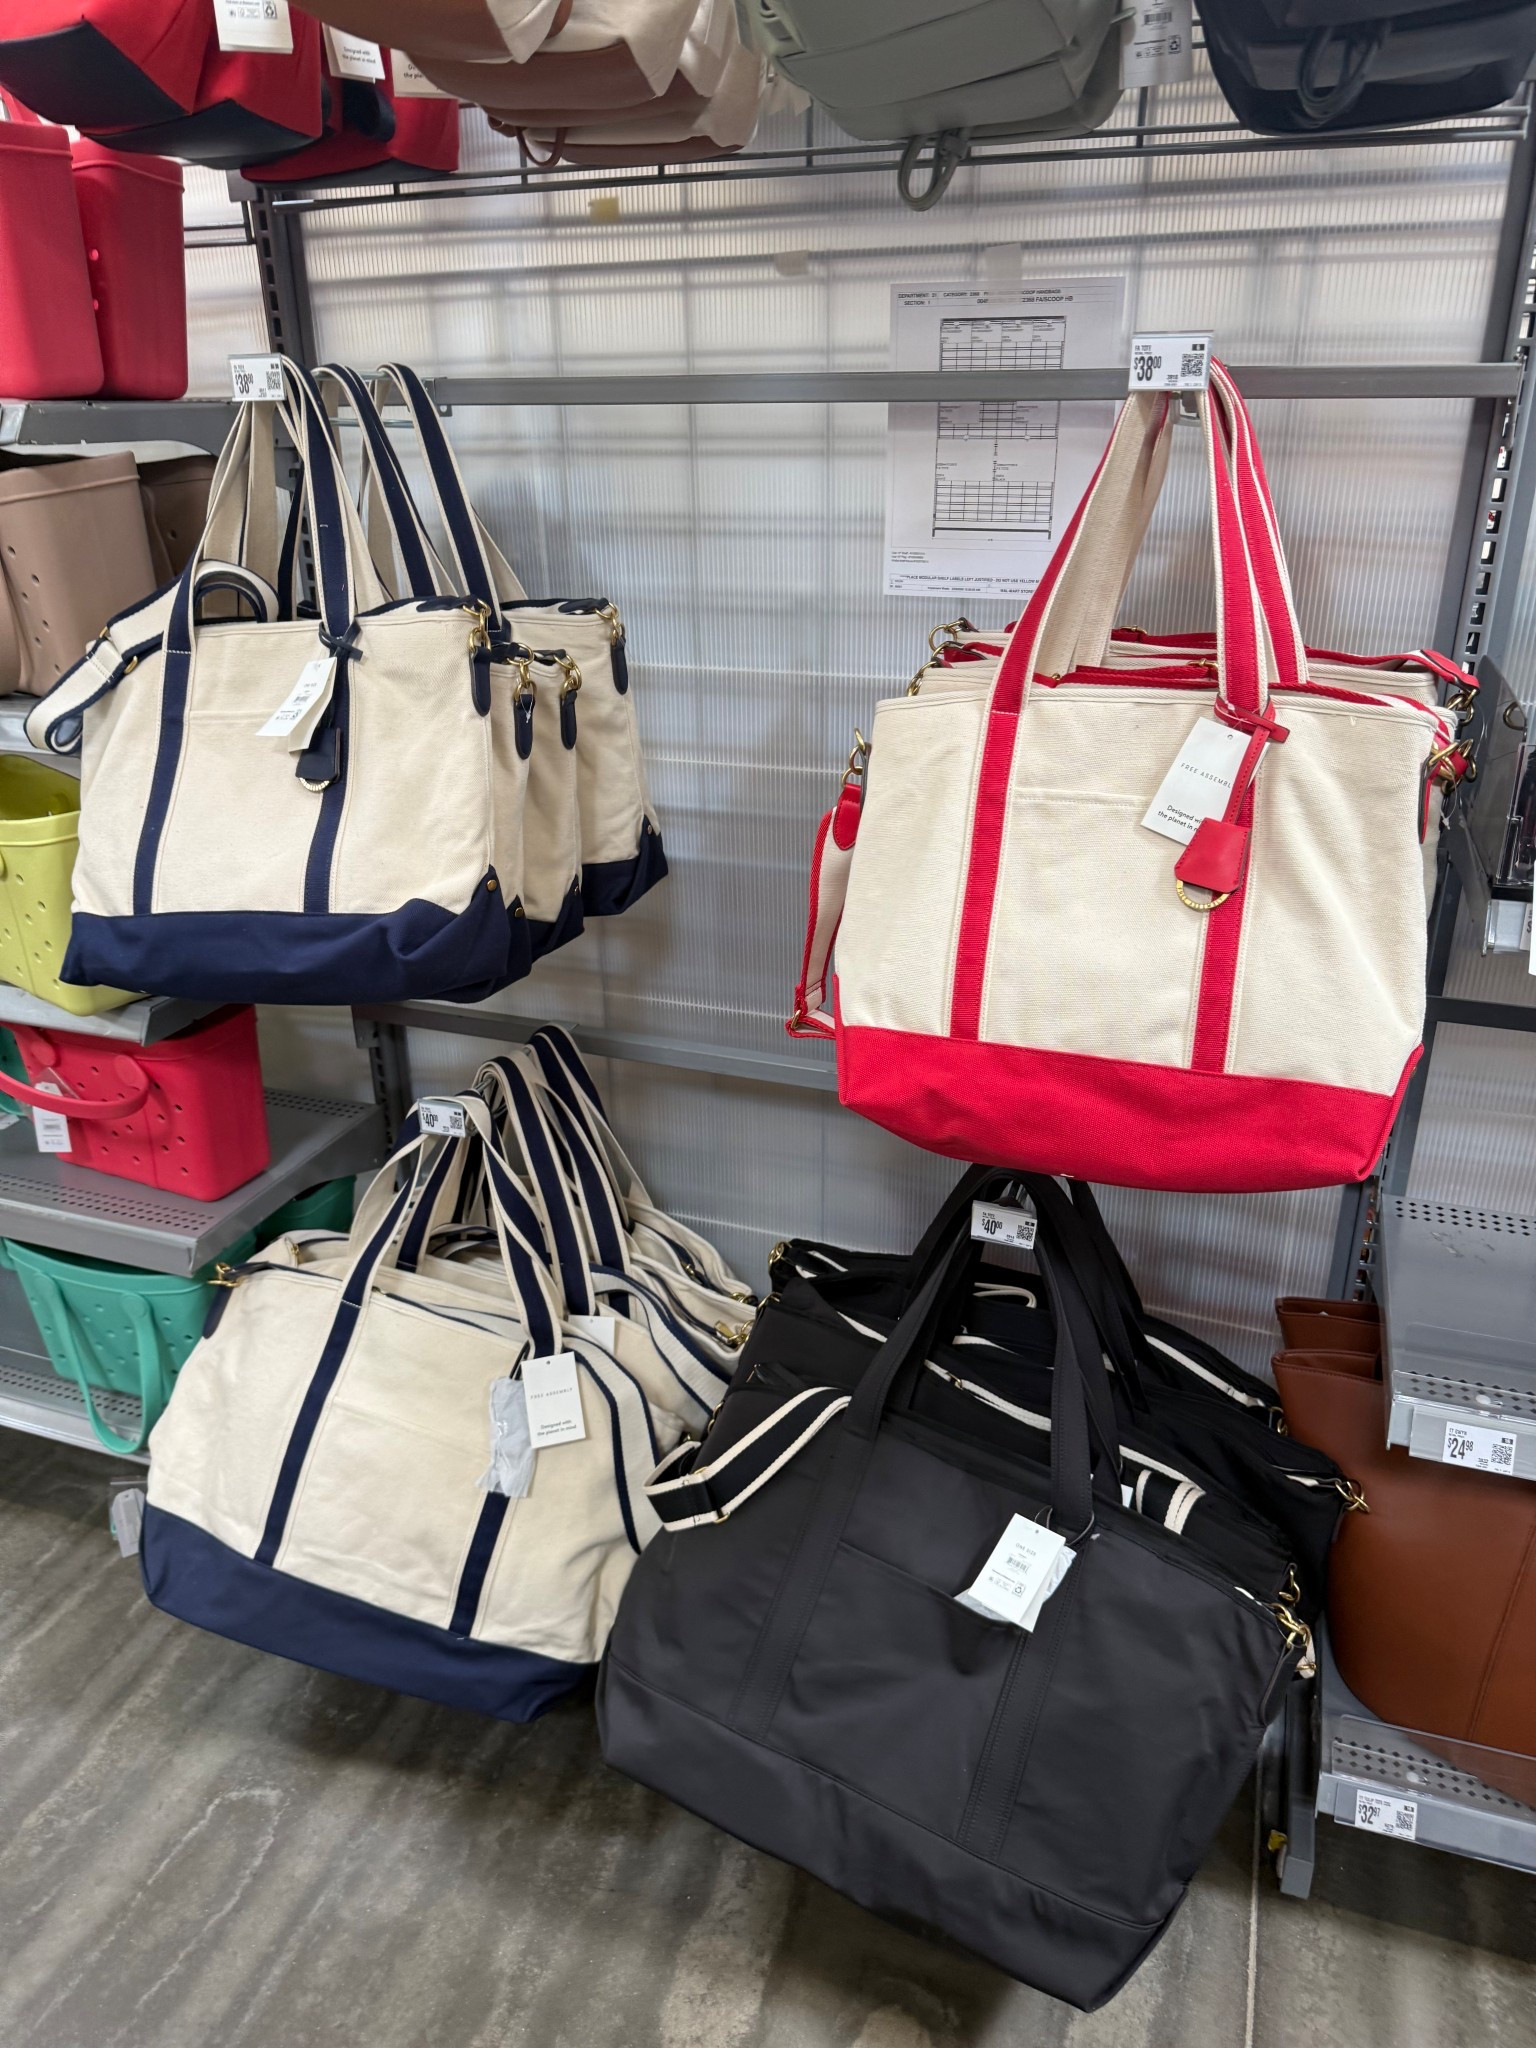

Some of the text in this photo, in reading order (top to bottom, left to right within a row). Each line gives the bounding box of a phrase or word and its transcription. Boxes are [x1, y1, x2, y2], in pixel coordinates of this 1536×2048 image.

[1180, 762, 1232, 789] FREE ASSEMBL
[1157, 811, 1168, 819] the
[1167, 815, 1187, 828] planet
[1187, 822, 1193, 830] in
[1166, 804, 1195, 821] Designed
